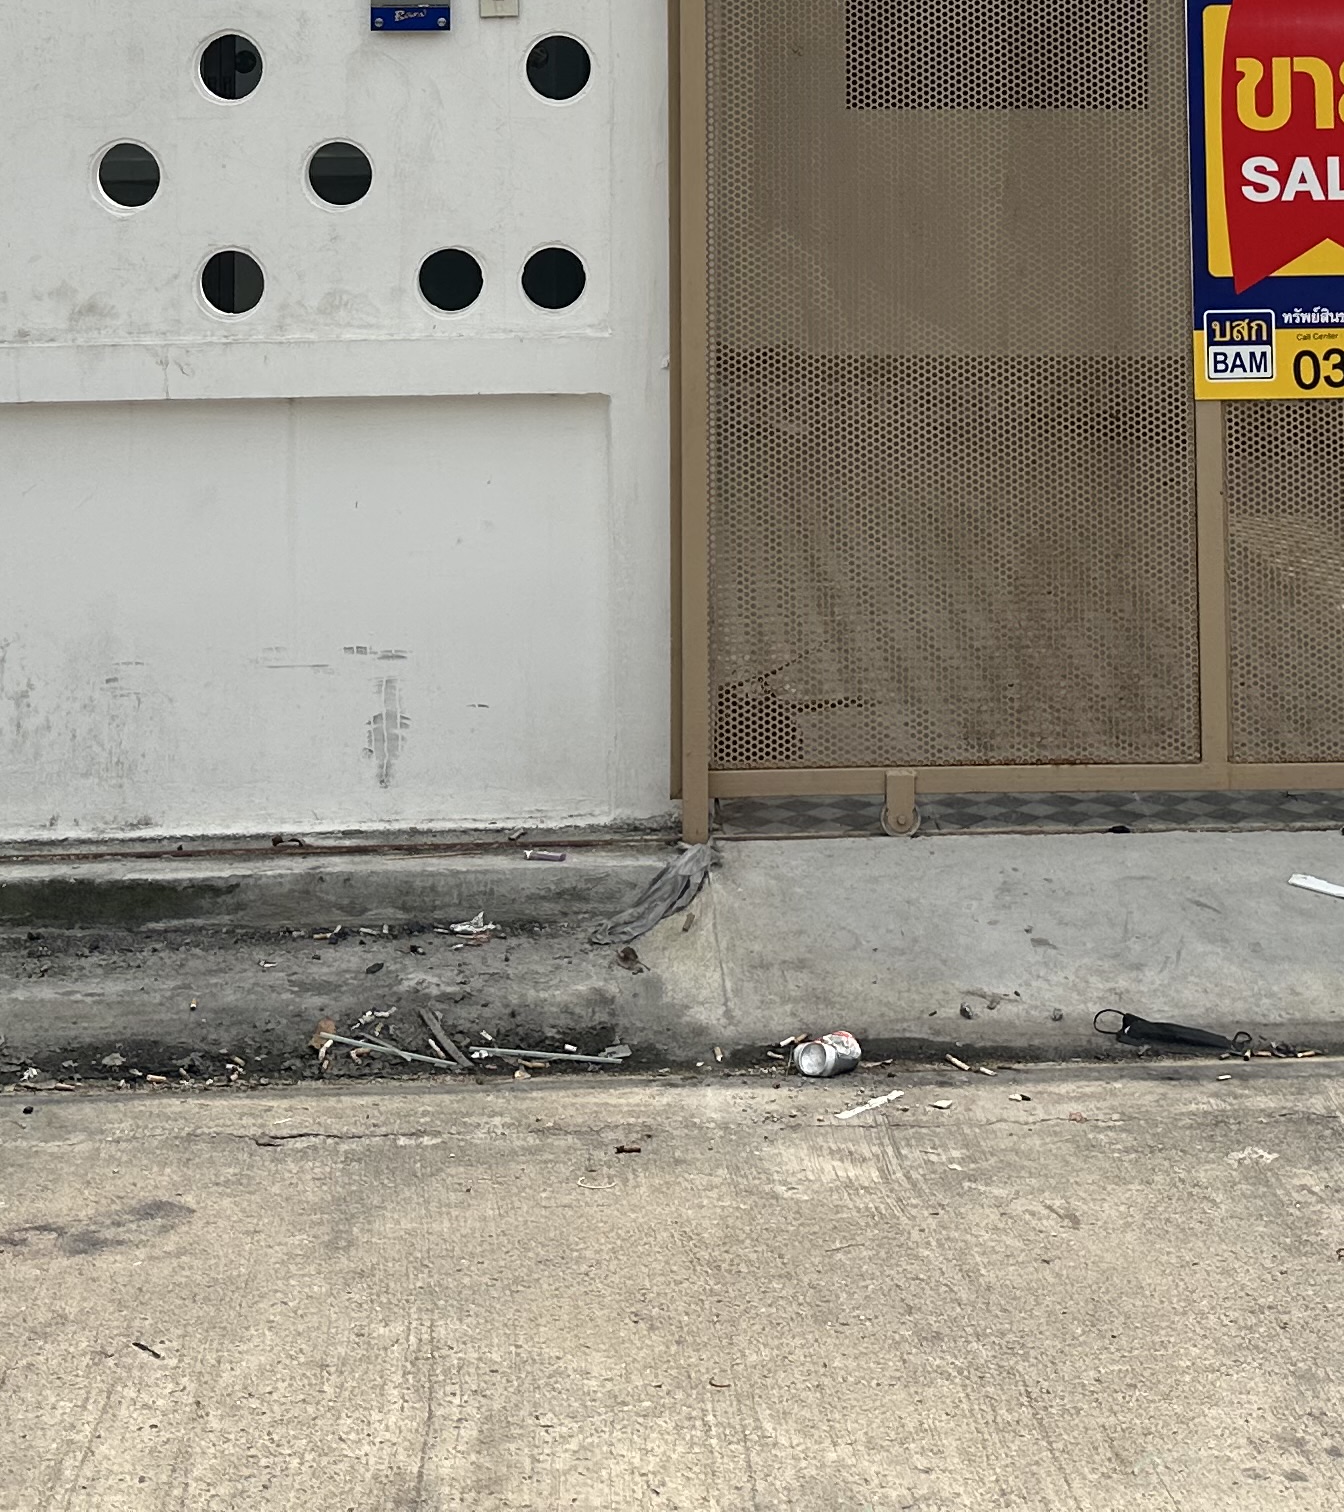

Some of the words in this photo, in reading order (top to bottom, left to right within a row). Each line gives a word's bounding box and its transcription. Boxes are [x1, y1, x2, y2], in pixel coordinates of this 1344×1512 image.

[1211, 318, 1268, 342] บสก
[1296, 333, 1311, 341] Call
[1313, 332, 1338, 341] Center
[1213, 351, 1268, 373] BAM
